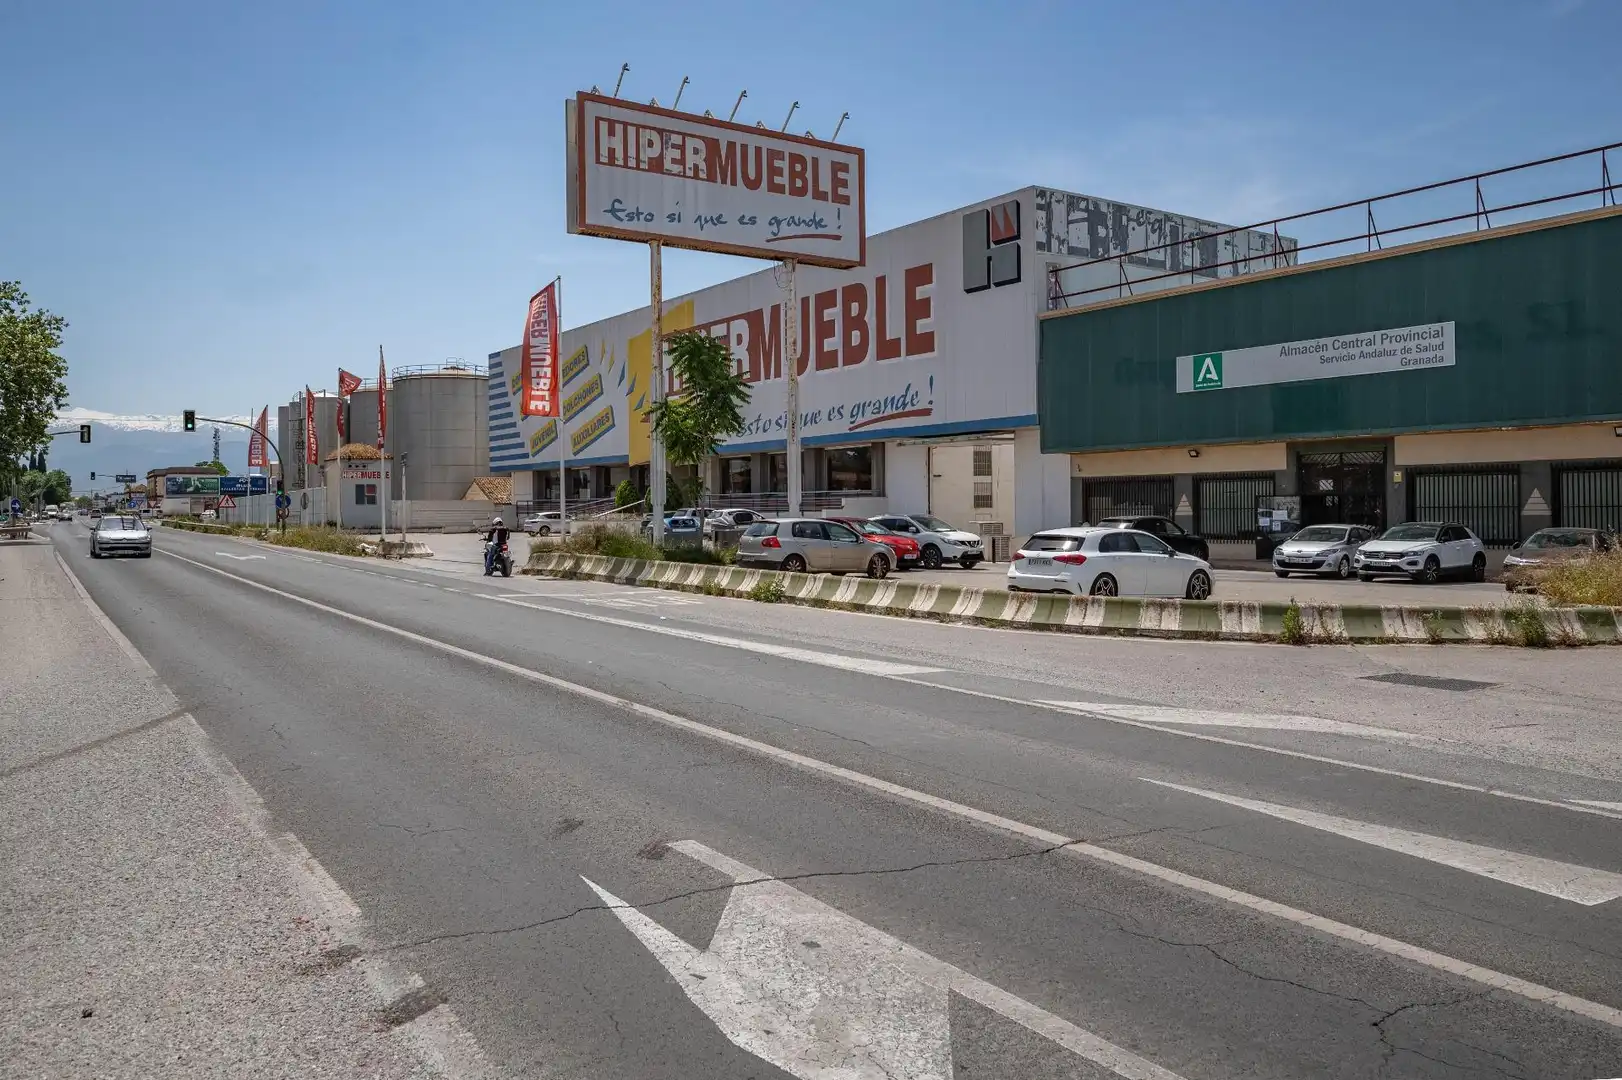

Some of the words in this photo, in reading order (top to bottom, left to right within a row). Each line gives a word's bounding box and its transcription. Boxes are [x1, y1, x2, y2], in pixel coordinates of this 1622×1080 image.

[595, 116, 850, 205] HIPERMUEBLE
[603, 198, 655, 222] Esto
[694, 210, 727, 231] que
[738, 212, 757, 226] es
[768, 214, 828, 236] grande
[661, 263, 935, 398] HRMUEBLE
[1279, 342, 1328, 357] Almacén
[1332, 335, 1376, 351] Central
[1381, 326, 1444, 345] Provincial
[1320, 352, 1356, 365] Servicio
[1359, 348, 1397, 360] Andaluz
[1400, 345, 1412, 355] de
[1415, 341, 1444, 354] Salud
[1400, 354, 1444, 367] Granada
[828, 404, 845, 421] es
[851, 383, 920, 425] grande
[342, 470, 390, 479] HIPERMUEBE
